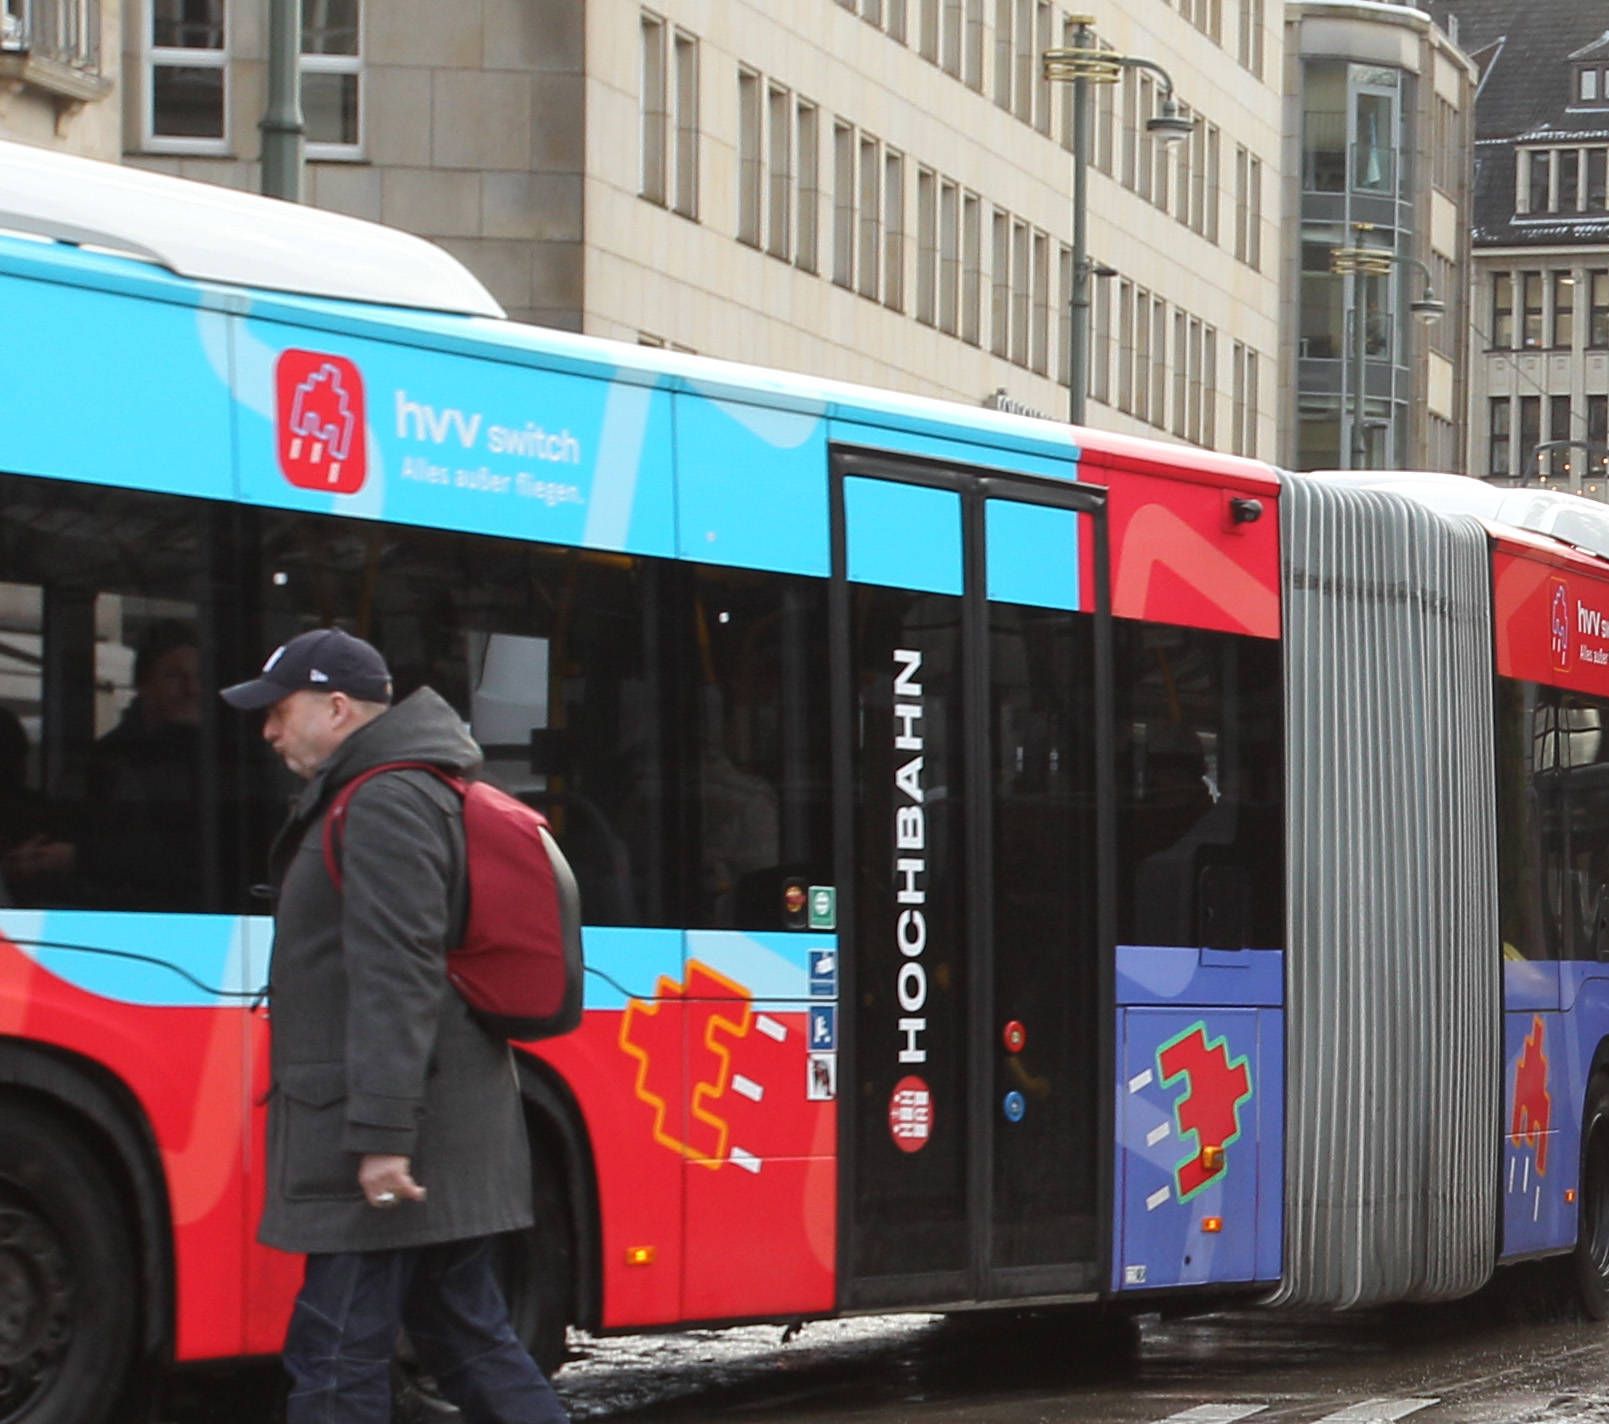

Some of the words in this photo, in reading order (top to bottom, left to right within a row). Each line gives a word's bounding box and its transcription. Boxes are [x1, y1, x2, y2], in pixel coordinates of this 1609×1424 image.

[395, 389, 482, 448] hvv
[488, 421, 580, 464] switch
[402, 456, 449, 485] Alles
[1577, 600, 1600, 636] hvv
[893, 649, 927, 1063] HOCHBAHN
